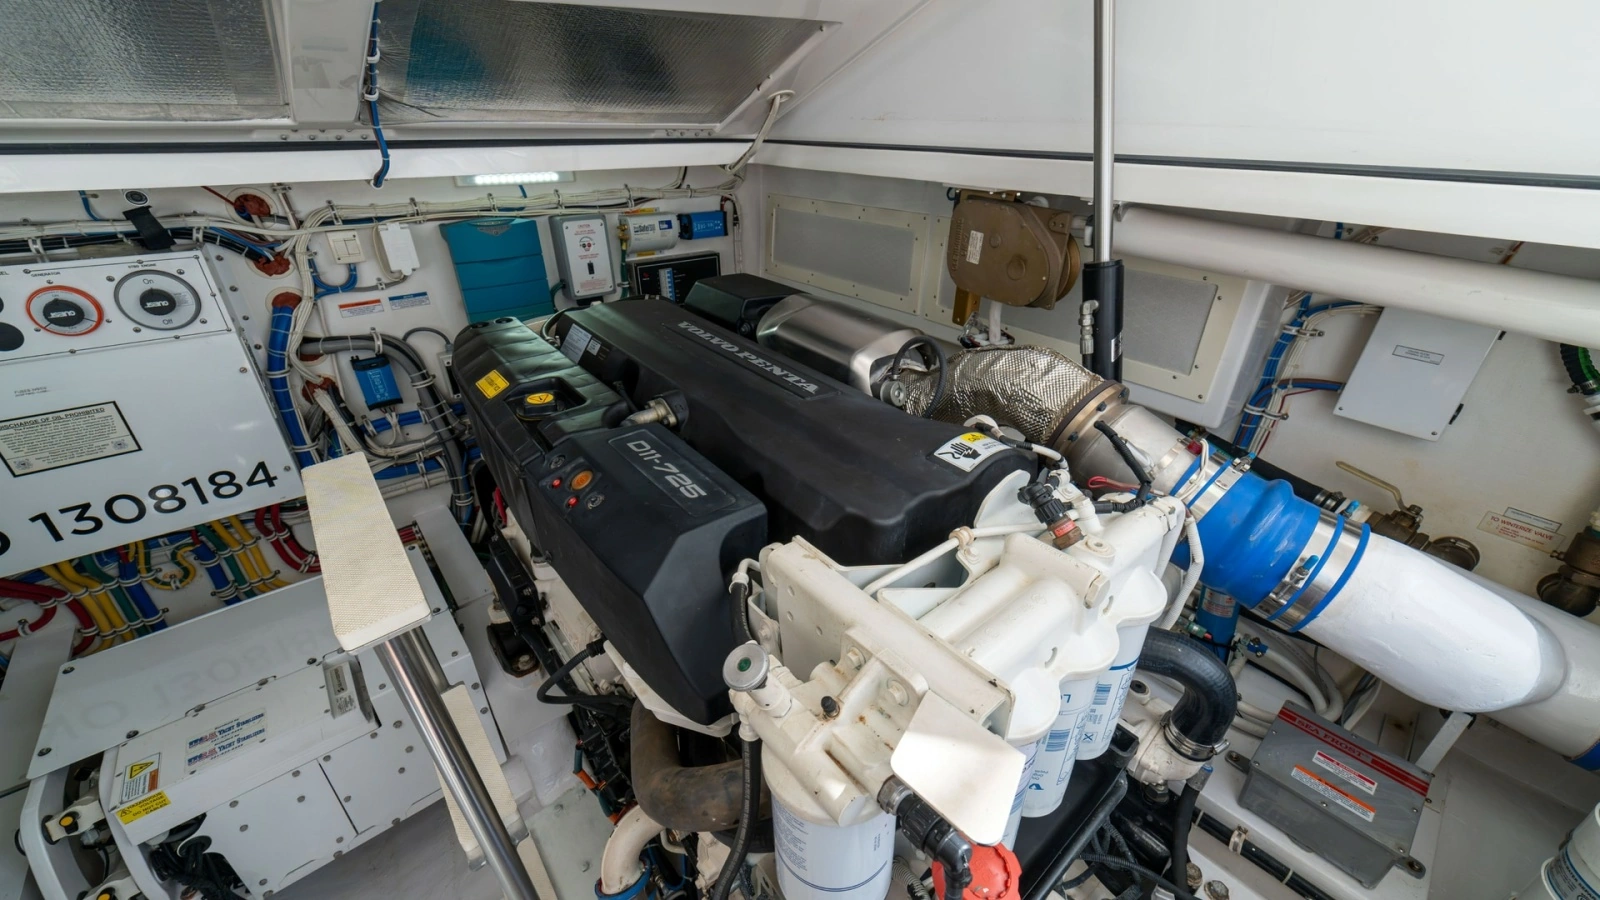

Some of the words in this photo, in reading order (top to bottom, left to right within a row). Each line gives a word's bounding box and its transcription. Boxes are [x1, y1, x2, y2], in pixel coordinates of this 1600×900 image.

[677, 320, 740, 352] VOLVO
[735, 350, 820, 394] PENTA
[64, 407, 105, 419] PROHIBITED
[626, 440, 708, 499] D11-725
[28, 461, 278, 542] 1308184
[1500, 518, 1533, 533] WINTERIZE
[1534, 530, 1554, 540] VALVE
[1296, 717, 1321, 735] SEA
[1322, 733, 1365, 757] FROST
